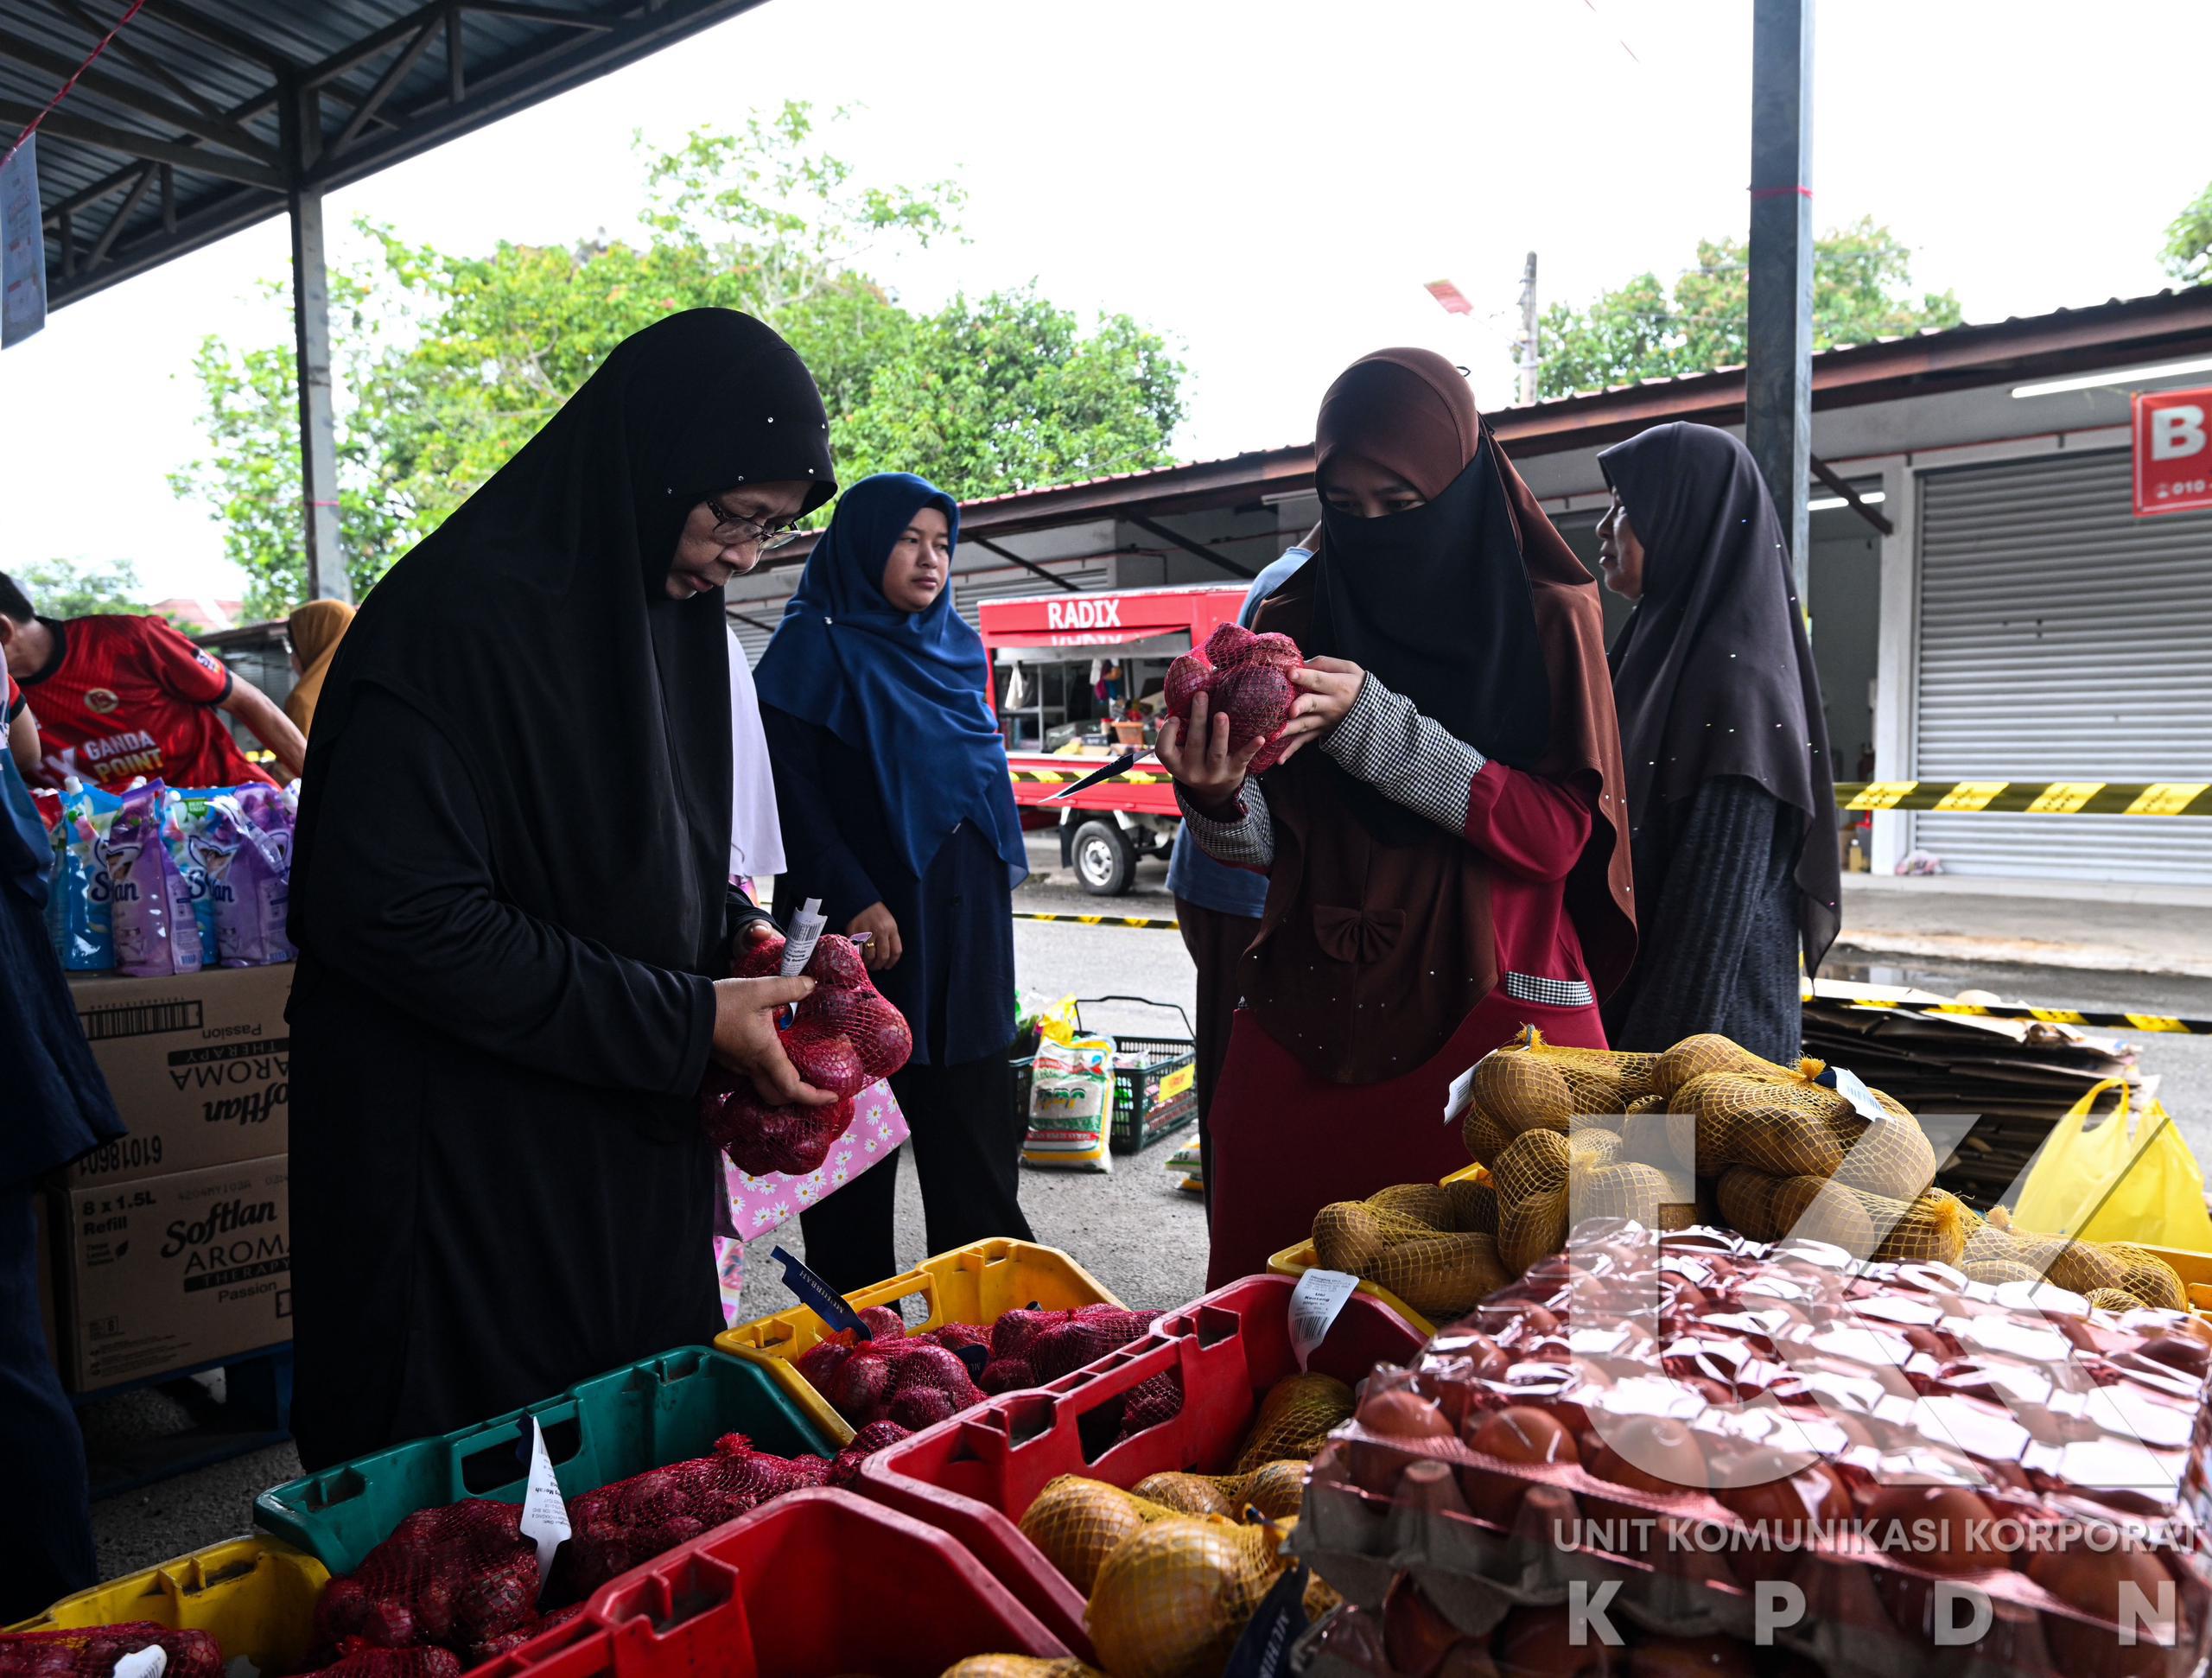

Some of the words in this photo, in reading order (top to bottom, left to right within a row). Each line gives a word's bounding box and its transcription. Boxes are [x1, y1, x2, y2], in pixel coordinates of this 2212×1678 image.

[1048, 599, 1122, 629] RADIX
[85, 729, 156, 760] GANDA
[93, 748, 164, 783] POINT
[202, 1023, 262, 1040] Passion
[183, 1040, 277, 1063] THERAPY
[169, 1056, 289, 1091] AROMA
[203, 1082, 289, 1126] oftlan
[83, 1201, 95, 1216] 8
[102, 1201, 112, 1213] x
[117, 1191, 156, 1210] 1.5L
[83, 1216, 128, 1236] Refill
[161, 1198, 277, 1258] Softlan
[184, 1234, 289, 1275] AROM
[218, 1281, 276, 1304] Passion
